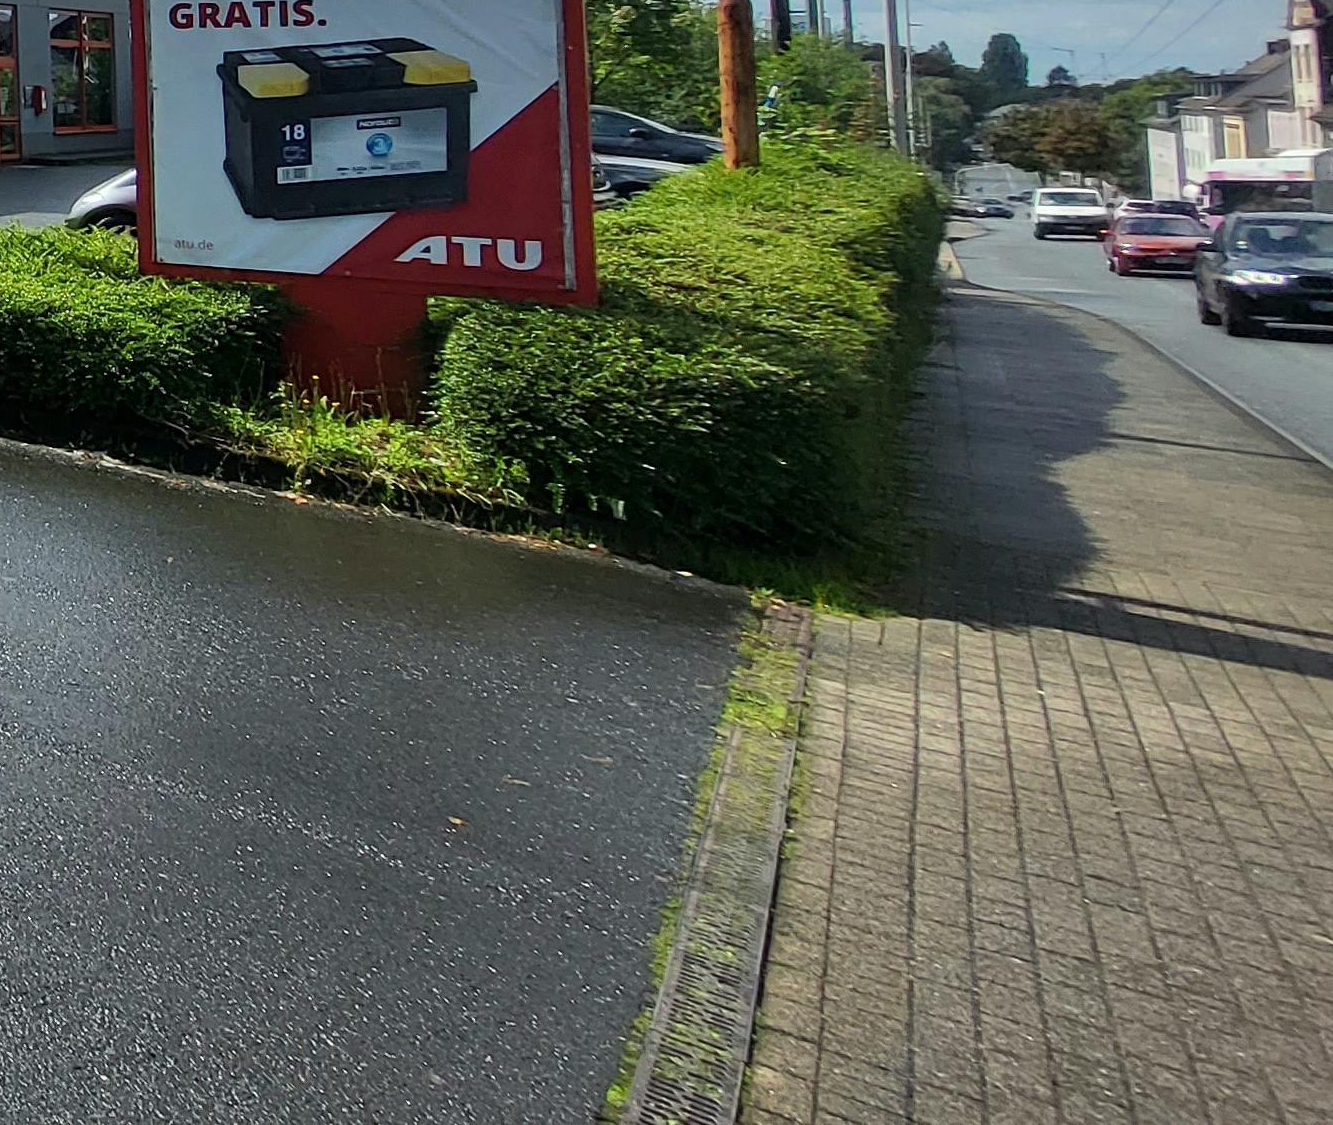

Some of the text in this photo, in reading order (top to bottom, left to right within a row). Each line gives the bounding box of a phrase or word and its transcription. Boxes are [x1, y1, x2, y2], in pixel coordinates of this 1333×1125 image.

[281, 124, 306, 141] 18
[173, 238, 214, 250] atu.de
[394, 236, 543, 271] ATU
